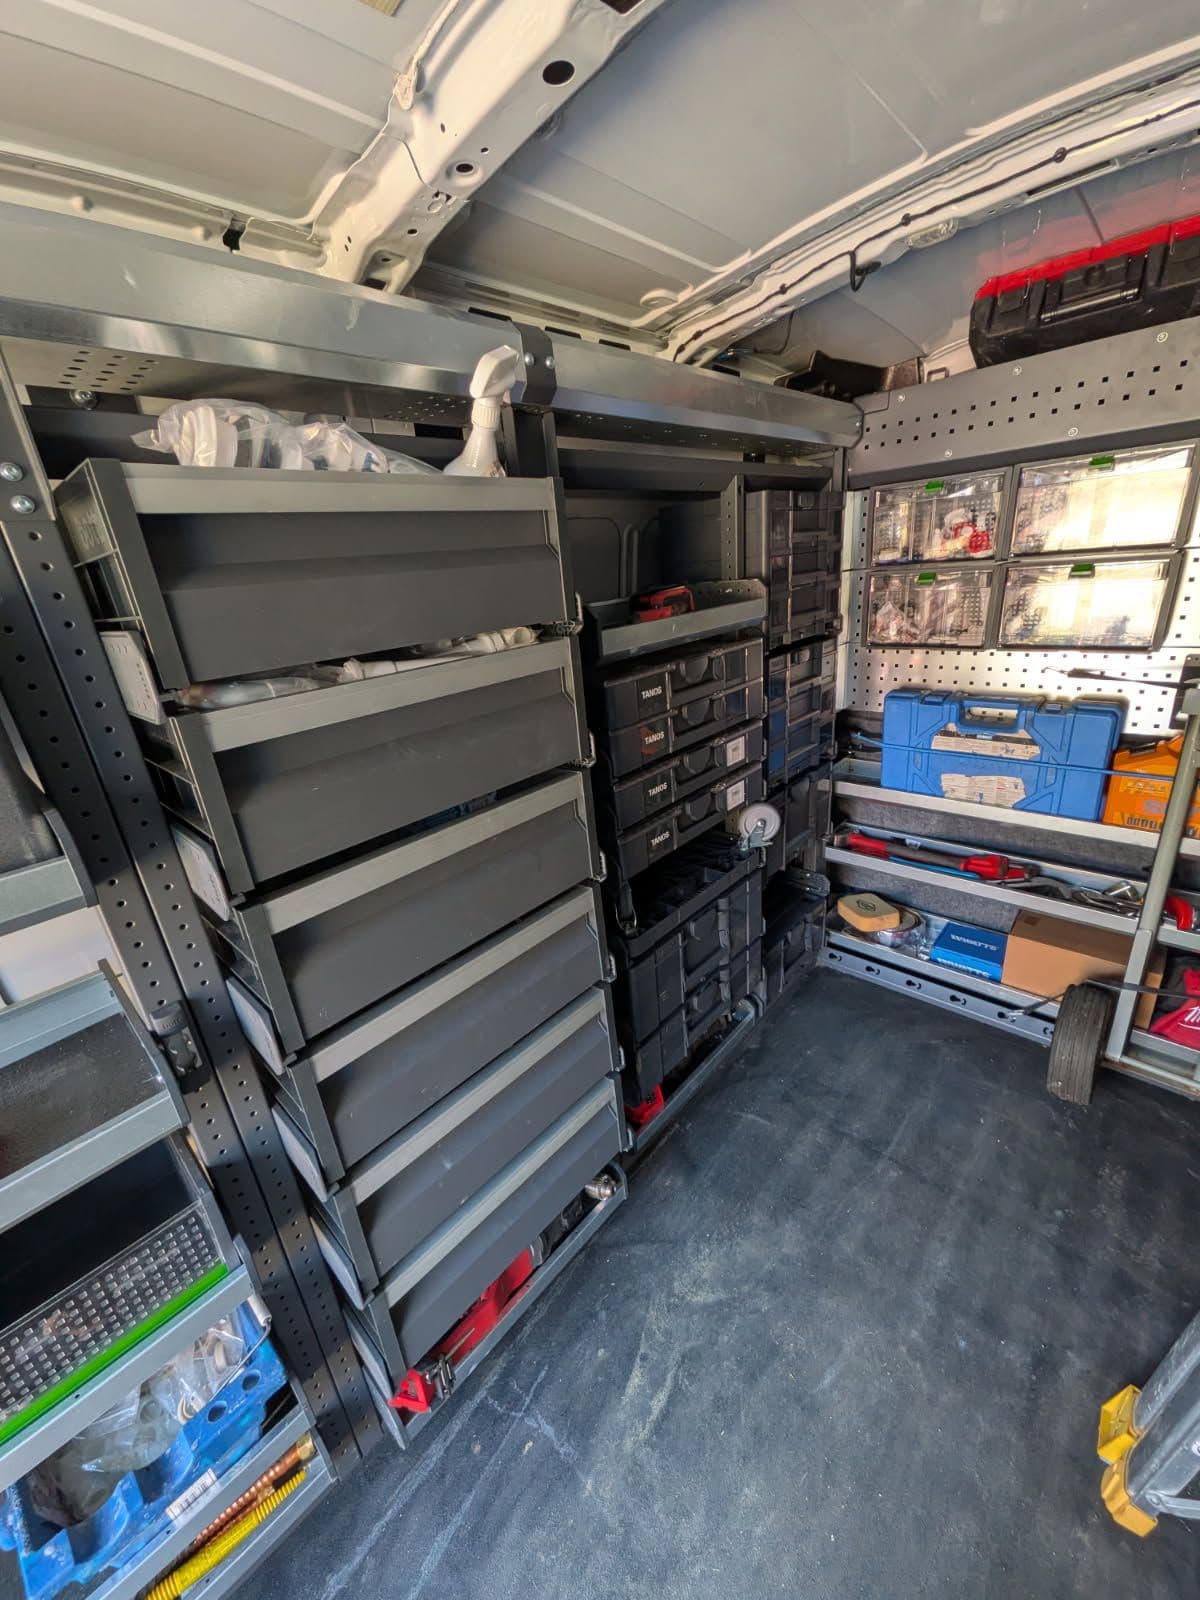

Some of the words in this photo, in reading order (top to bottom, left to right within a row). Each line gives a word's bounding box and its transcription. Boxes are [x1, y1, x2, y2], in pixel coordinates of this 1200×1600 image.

[641, 686, 662, 699] TANOS
[644, 731, 665, 744] TANOS
[648, 782, 668, 796] TANOS
[651, 831, 671, 846] TANOS
